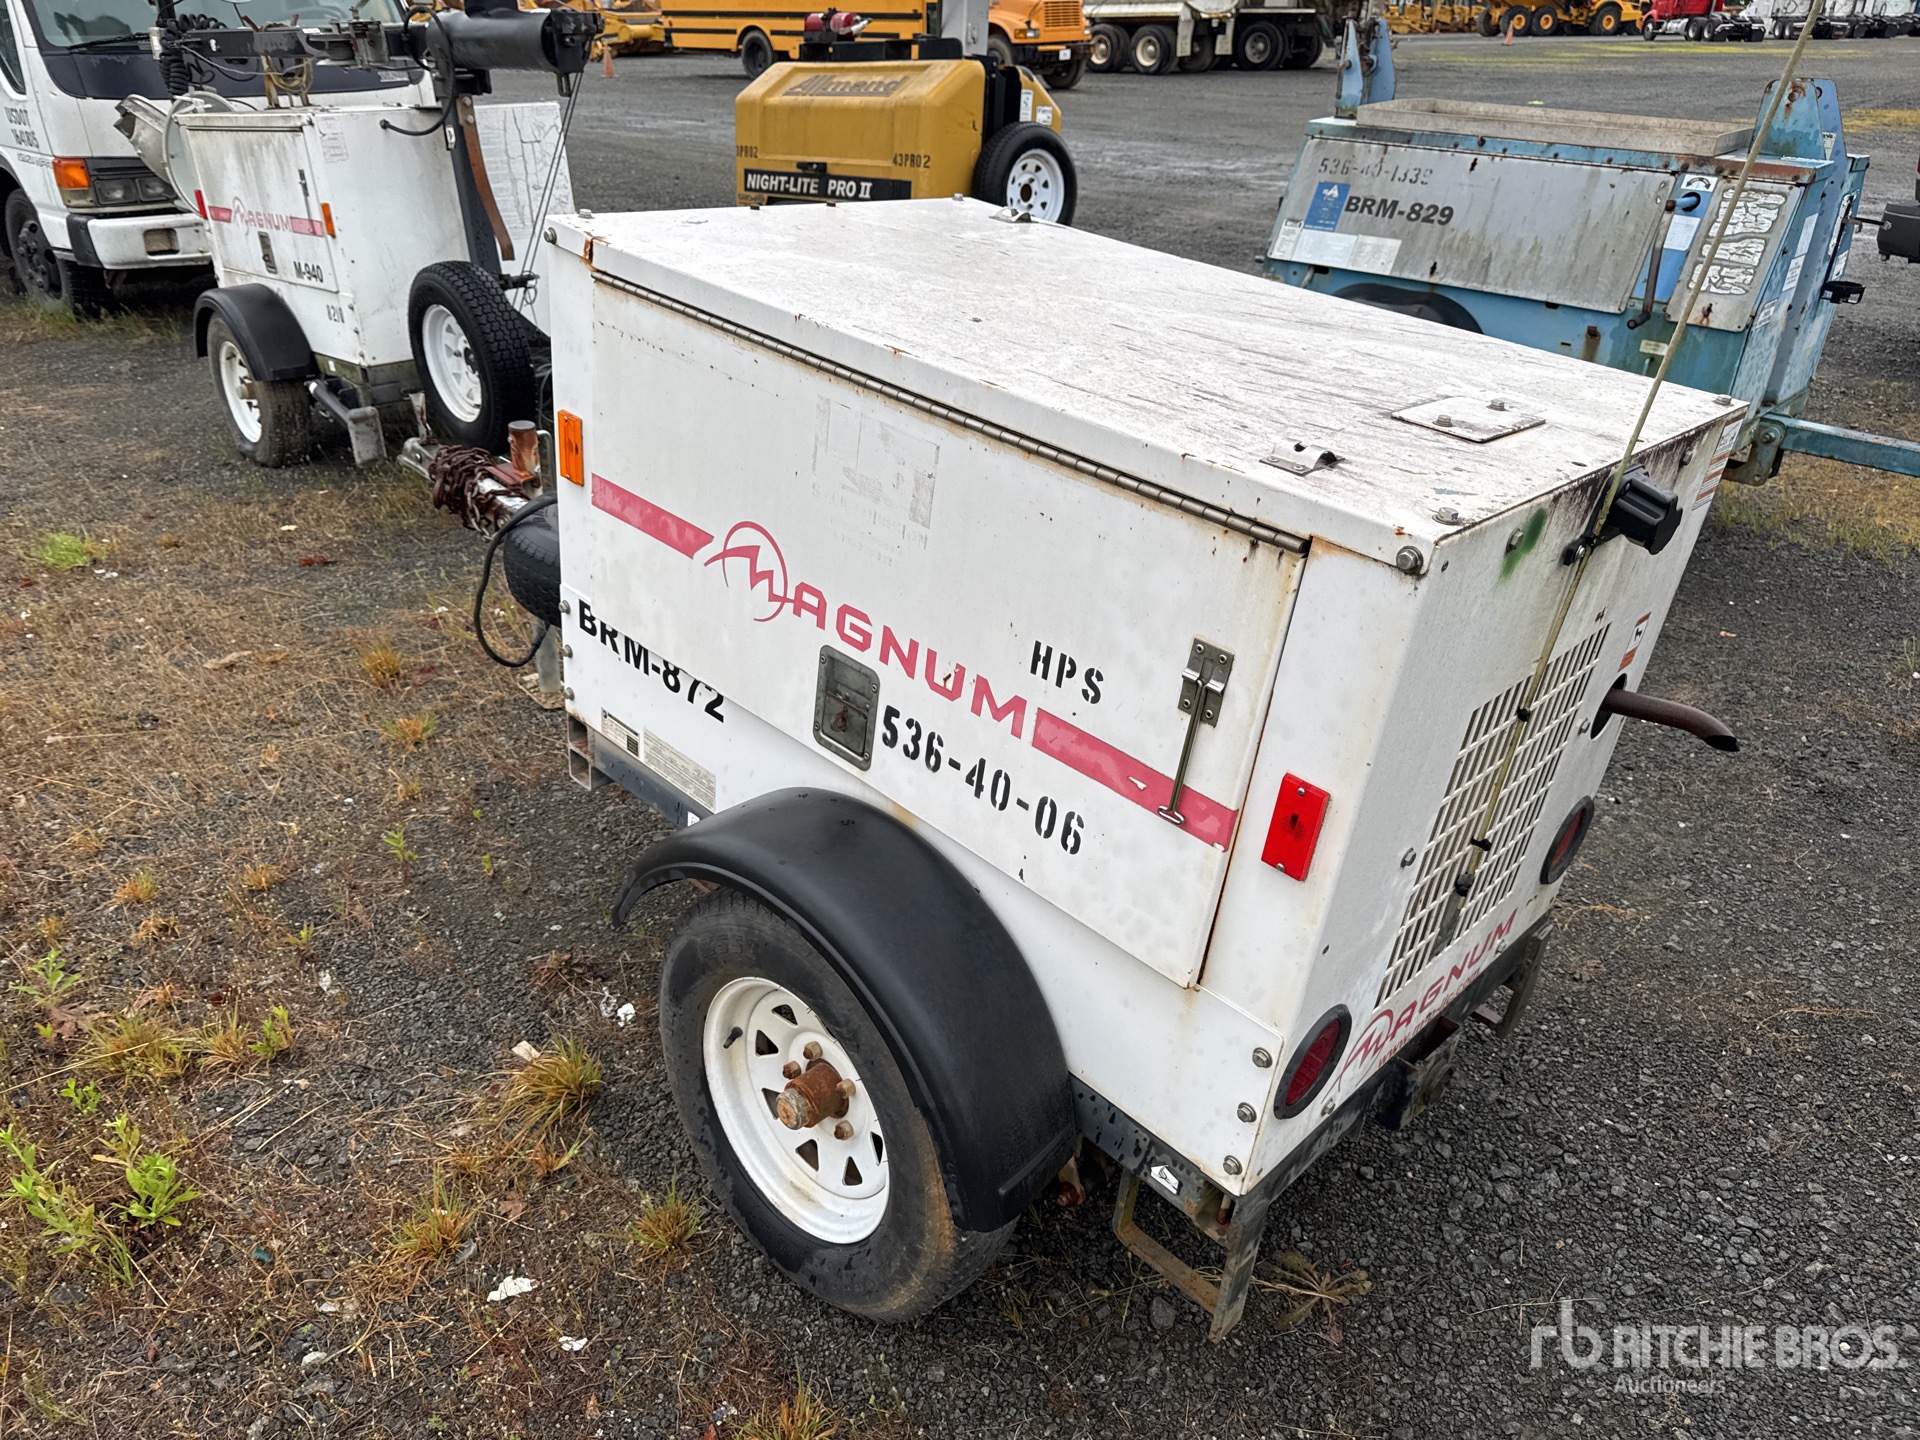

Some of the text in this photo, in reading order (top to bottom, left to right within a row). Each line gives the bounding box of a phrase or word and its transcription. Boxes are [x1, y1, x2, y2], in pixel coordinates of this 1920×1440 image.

[746, 173, 873, 199] NIGHT-LITE PRO II
[1345, 195, 1454, 226] BRM-829
[293, 261, 324, 283] M-940
[703, 520, 1028, 739] MAGNUM
[1031, 640, 1104, 704] HPS
[881, 705, 1085, 856] 536-40-06
[1321, 908, 1518, 1104] MAGNUM
